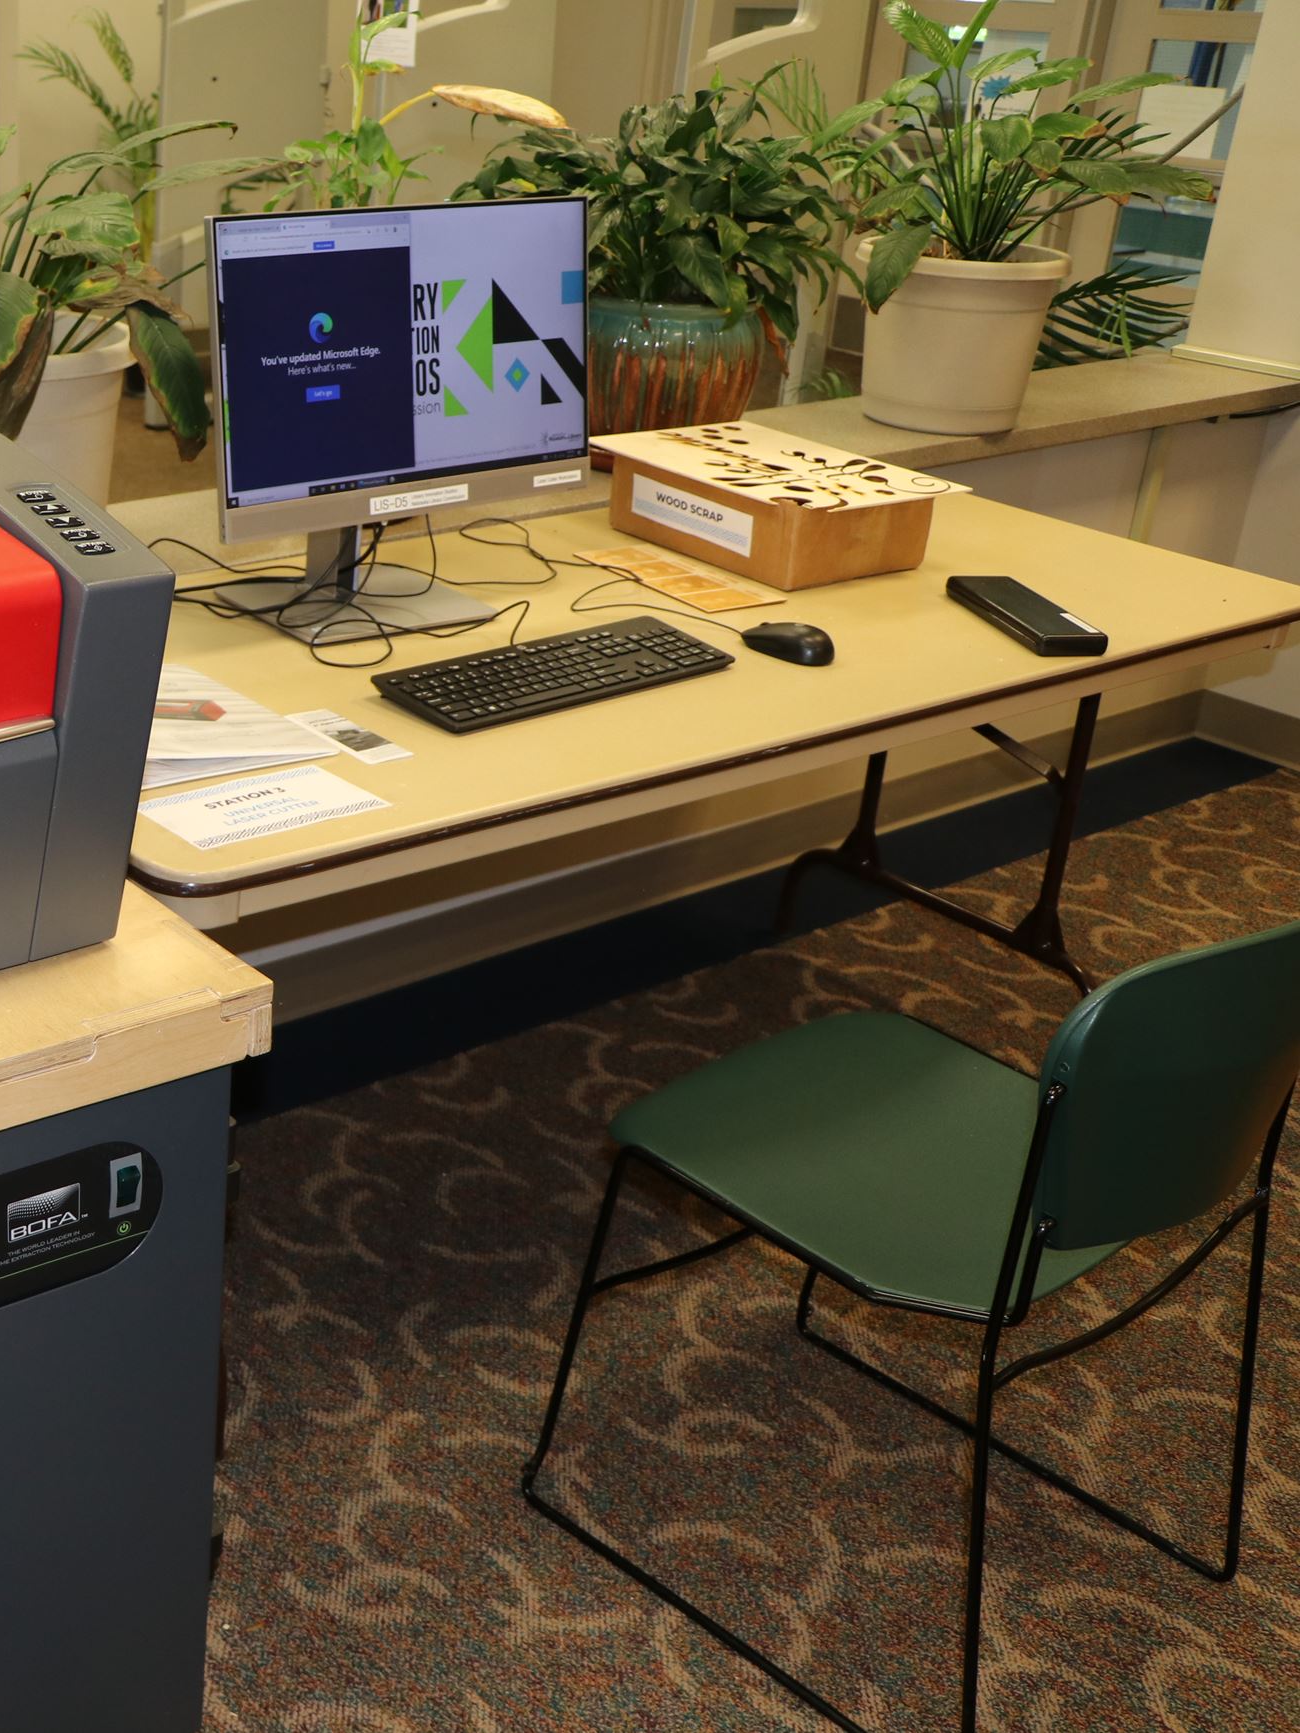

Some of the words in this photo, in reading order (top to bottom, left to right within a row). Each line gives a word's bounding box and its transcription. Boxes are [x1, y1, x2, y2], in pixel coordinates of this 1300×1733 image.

[413, 282, 438, 321] RY
[261, 355, 288, 366] You've
[289, 351, 321, 365] updated
[323, 346, 359, 360] Microsoft
[360, 345, 381, 358] Edge.
[288, 366, 311, 376] Here's
[312, 363, 335, 373] what's
[415, 358, 440, 397] OS
[374, 495, 409, 512] LIS-D5
[656, 492, 688, 511] WOOD
[690, 504, 723, 523] SCRAP
[203, 787, 273, 810] STATION
[224, 797, 299, 817] UNIVERSAL
[224, 811, 266, 826] LASER
[269, 800, 318, 817] CUTTER
[10, 1211, 78, 1241] BOFA
[8, 1248, 21, 1257] THE
[22, 1240, 46, 1253] WORLD
[46, 1233, 71, 1246] LEADER
[11, 1248, 50, 1263] EXTRACTION
[52, 1232, 96, 1249] TECHNOLOGY
